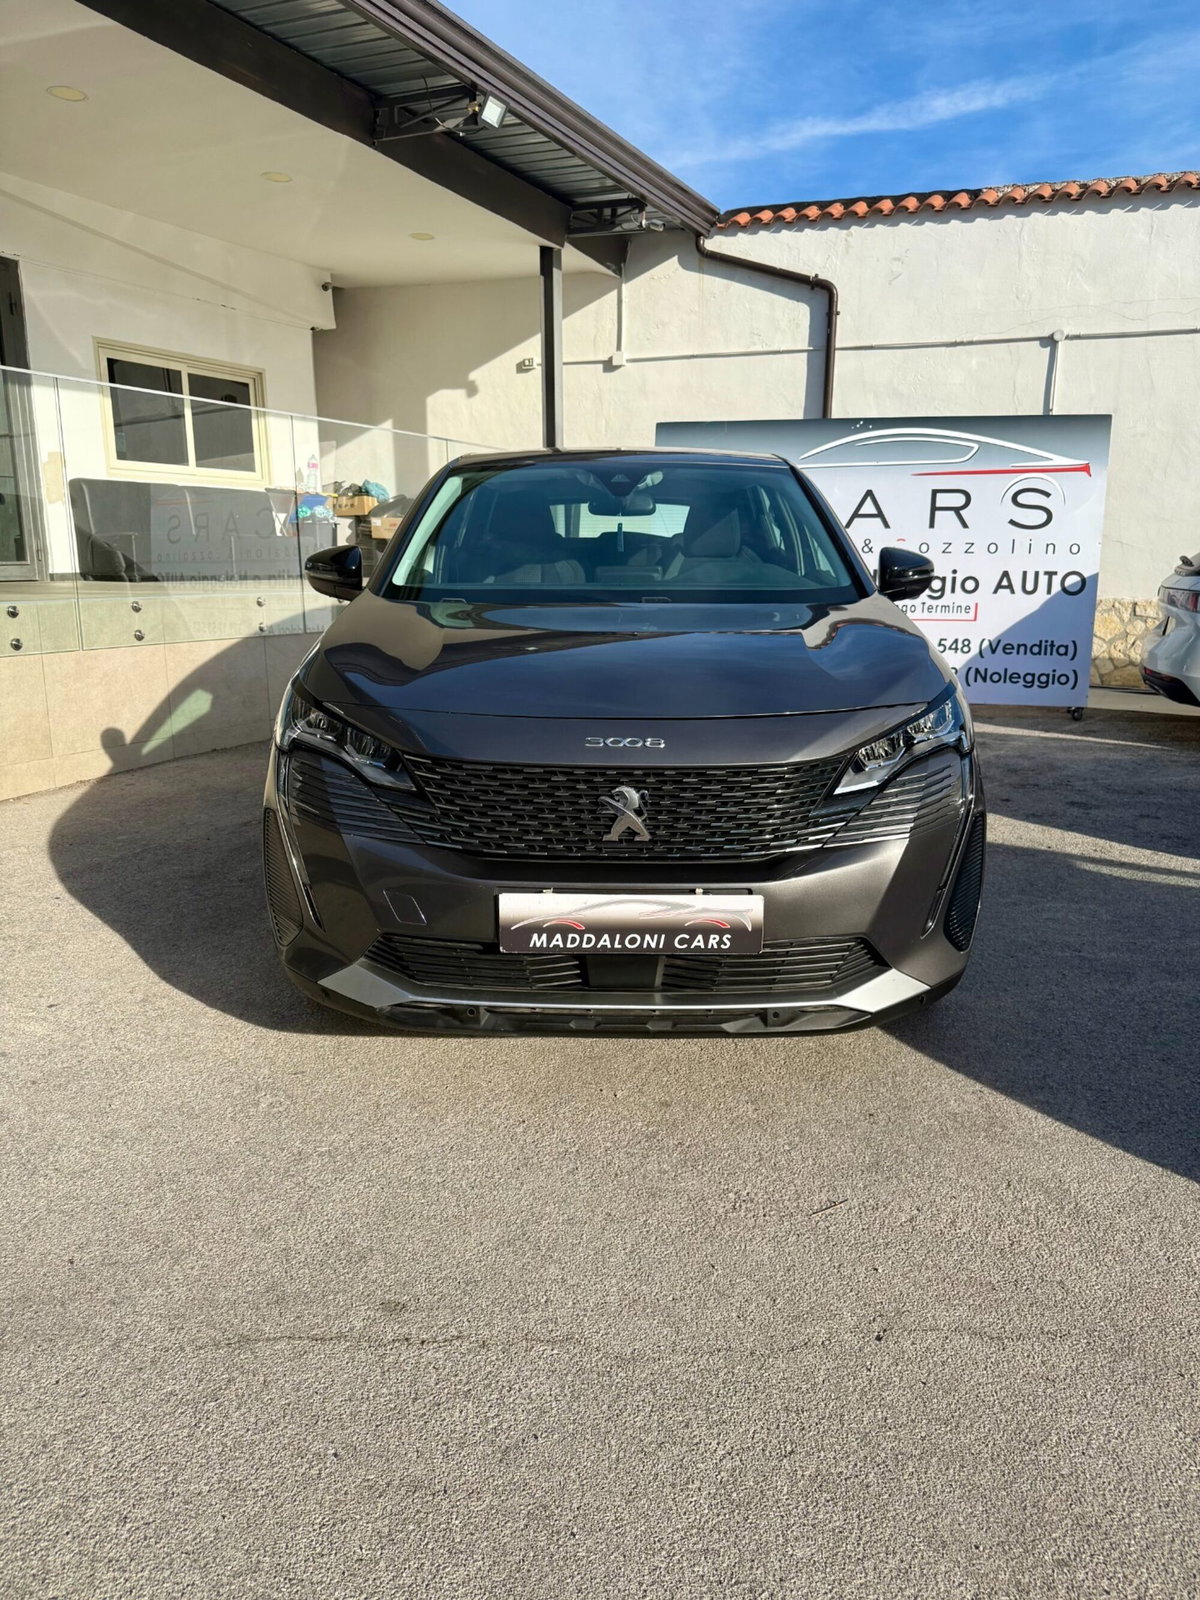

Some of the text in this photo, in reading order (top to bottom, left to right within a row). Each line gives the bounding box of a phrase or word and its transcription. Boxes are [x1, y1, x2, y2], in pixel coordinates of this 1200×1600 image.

[845, 487, 1053, 530] ARS
[861, 538, 1081, 555] & ozzolino
[992, 570, 1087, 596] AUTO
[921, 602, 971, 614] Termine
[937, 638, 1078, 661] 548 (Vendita)
[965, 666, 1079, 689] (Noleggio)
[585, 737, 665, 748] 3008
[529, 933, 732, 949] MADDALONI CARS
